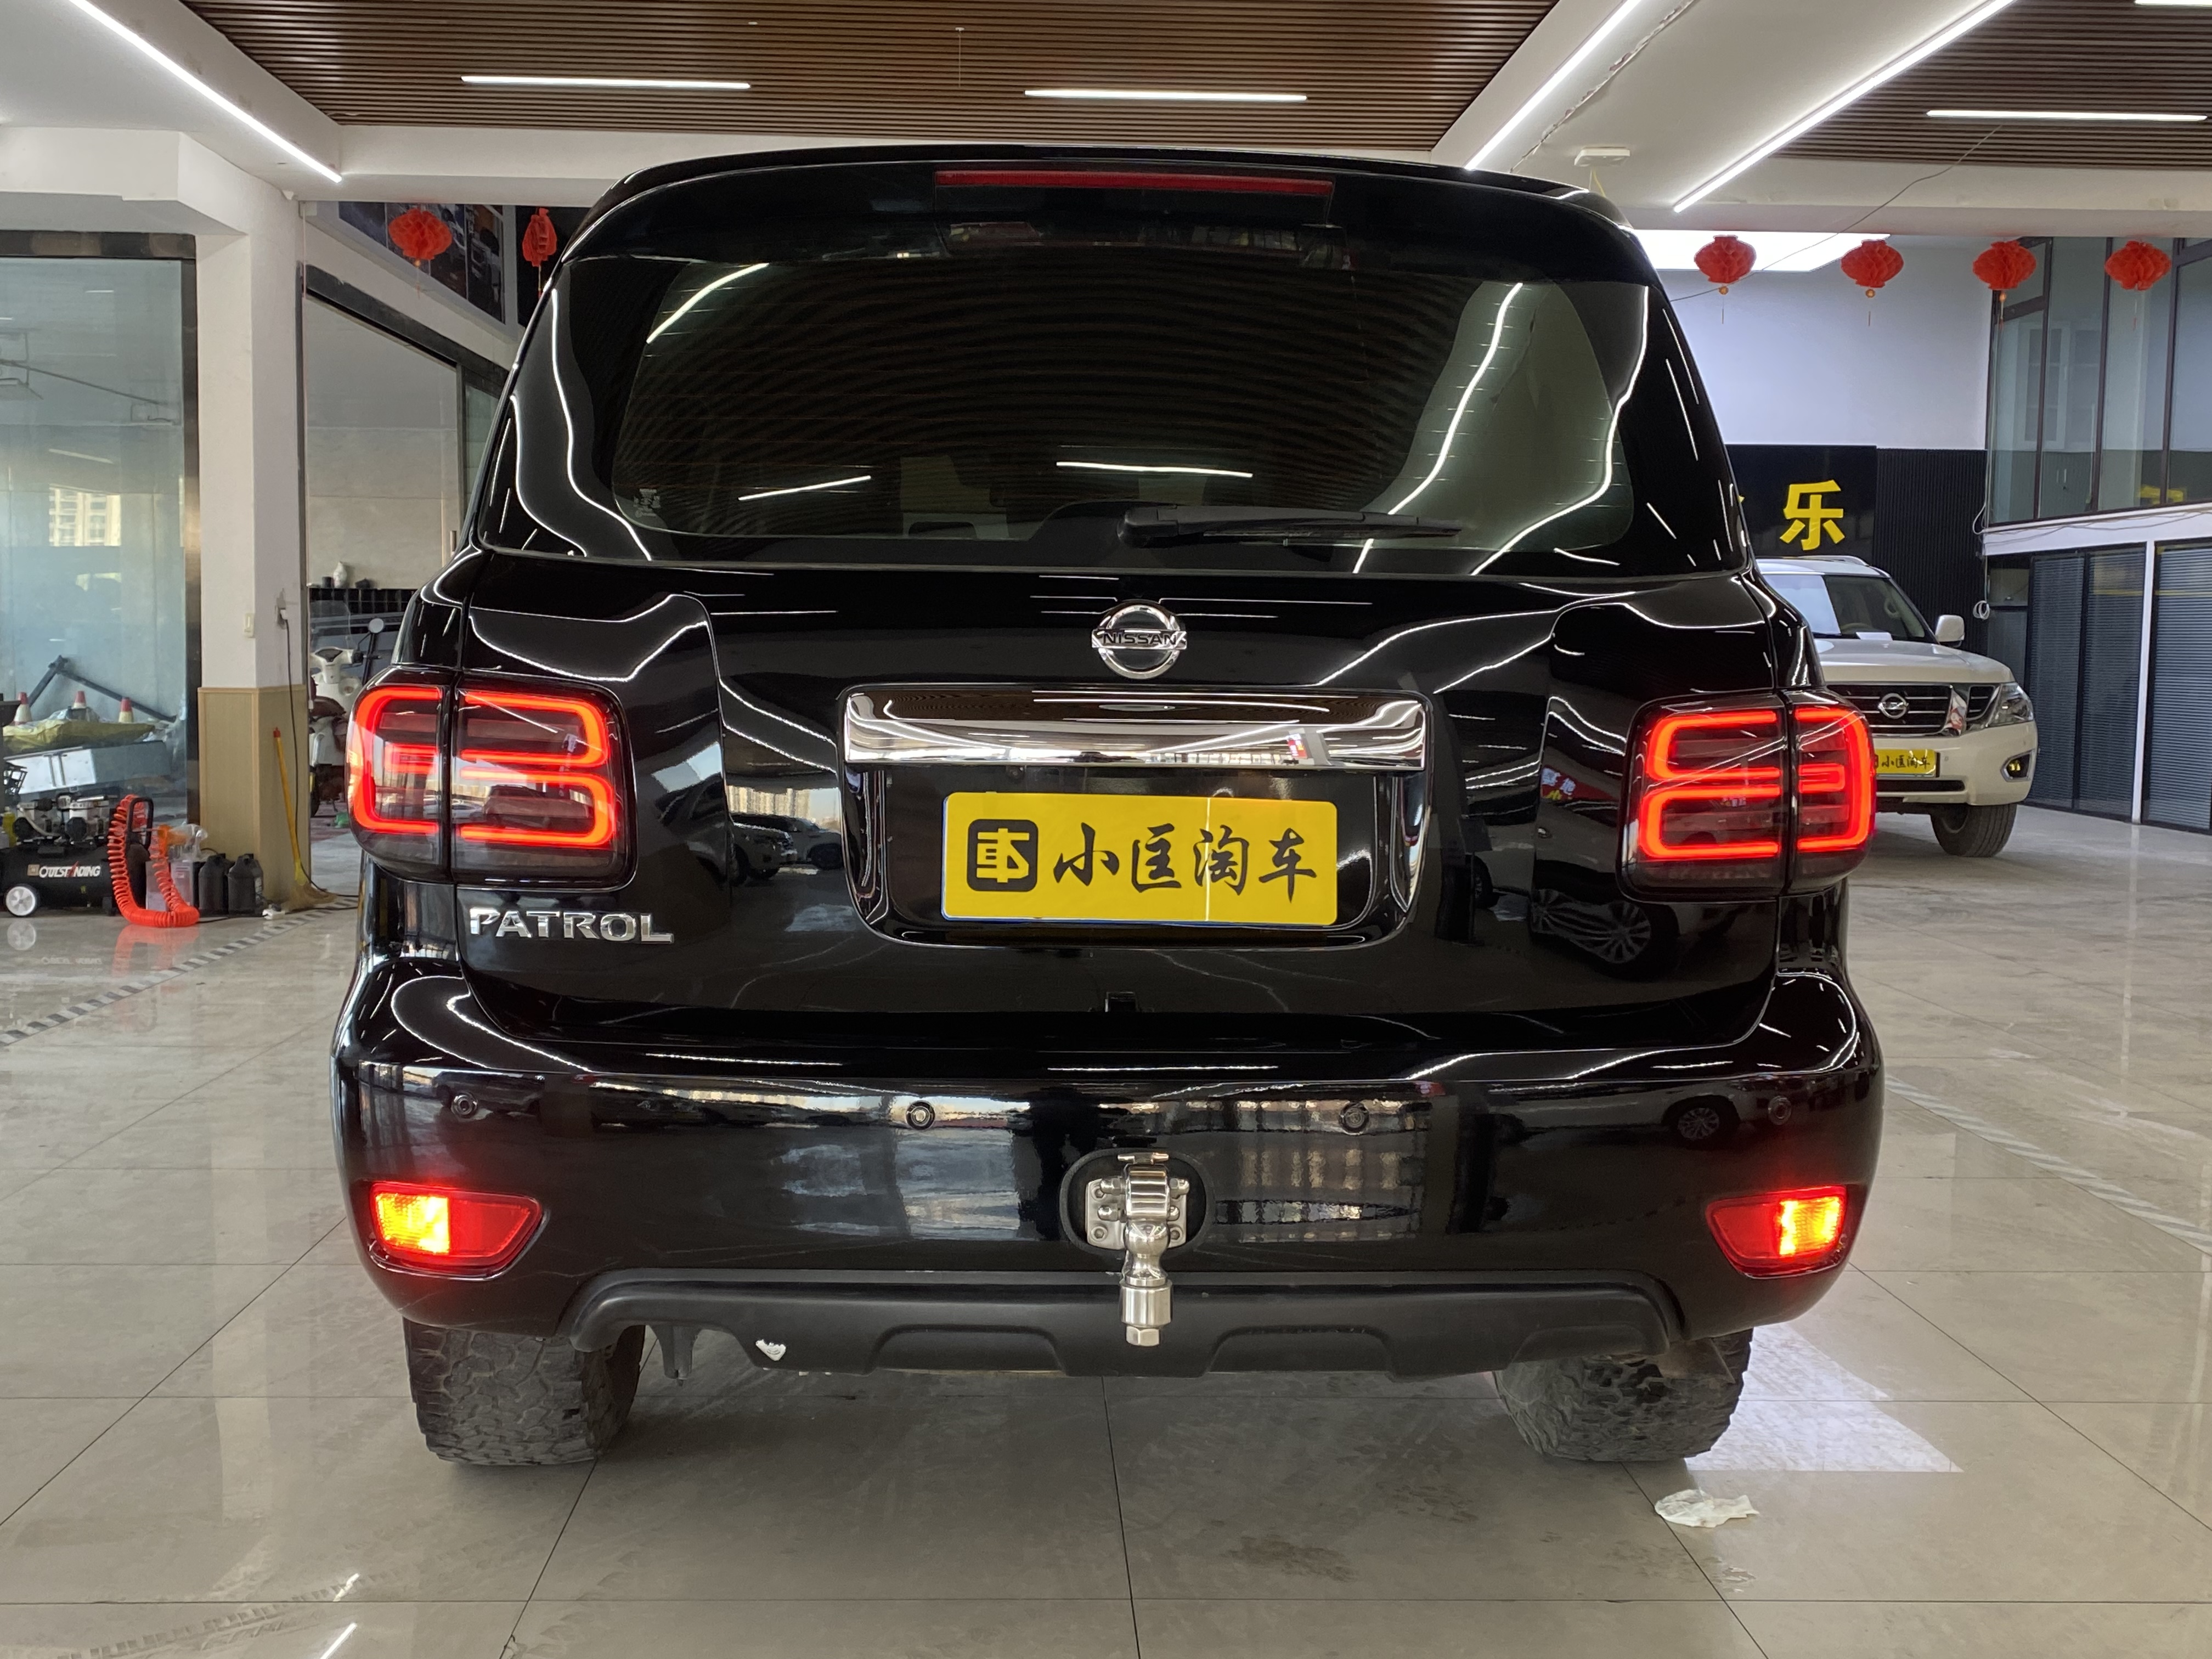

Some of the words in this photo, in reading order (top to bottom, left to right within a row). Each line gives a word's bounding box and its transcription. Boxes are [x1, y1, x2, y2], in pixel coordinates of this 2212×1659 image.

[1779, 479, 1846, 551] 乐
[1103, 632, 1177, 646] NISSAN
[1053, 822, 1317, 904] 小匡淘车
[469, 906, 675, 945] PATROL
